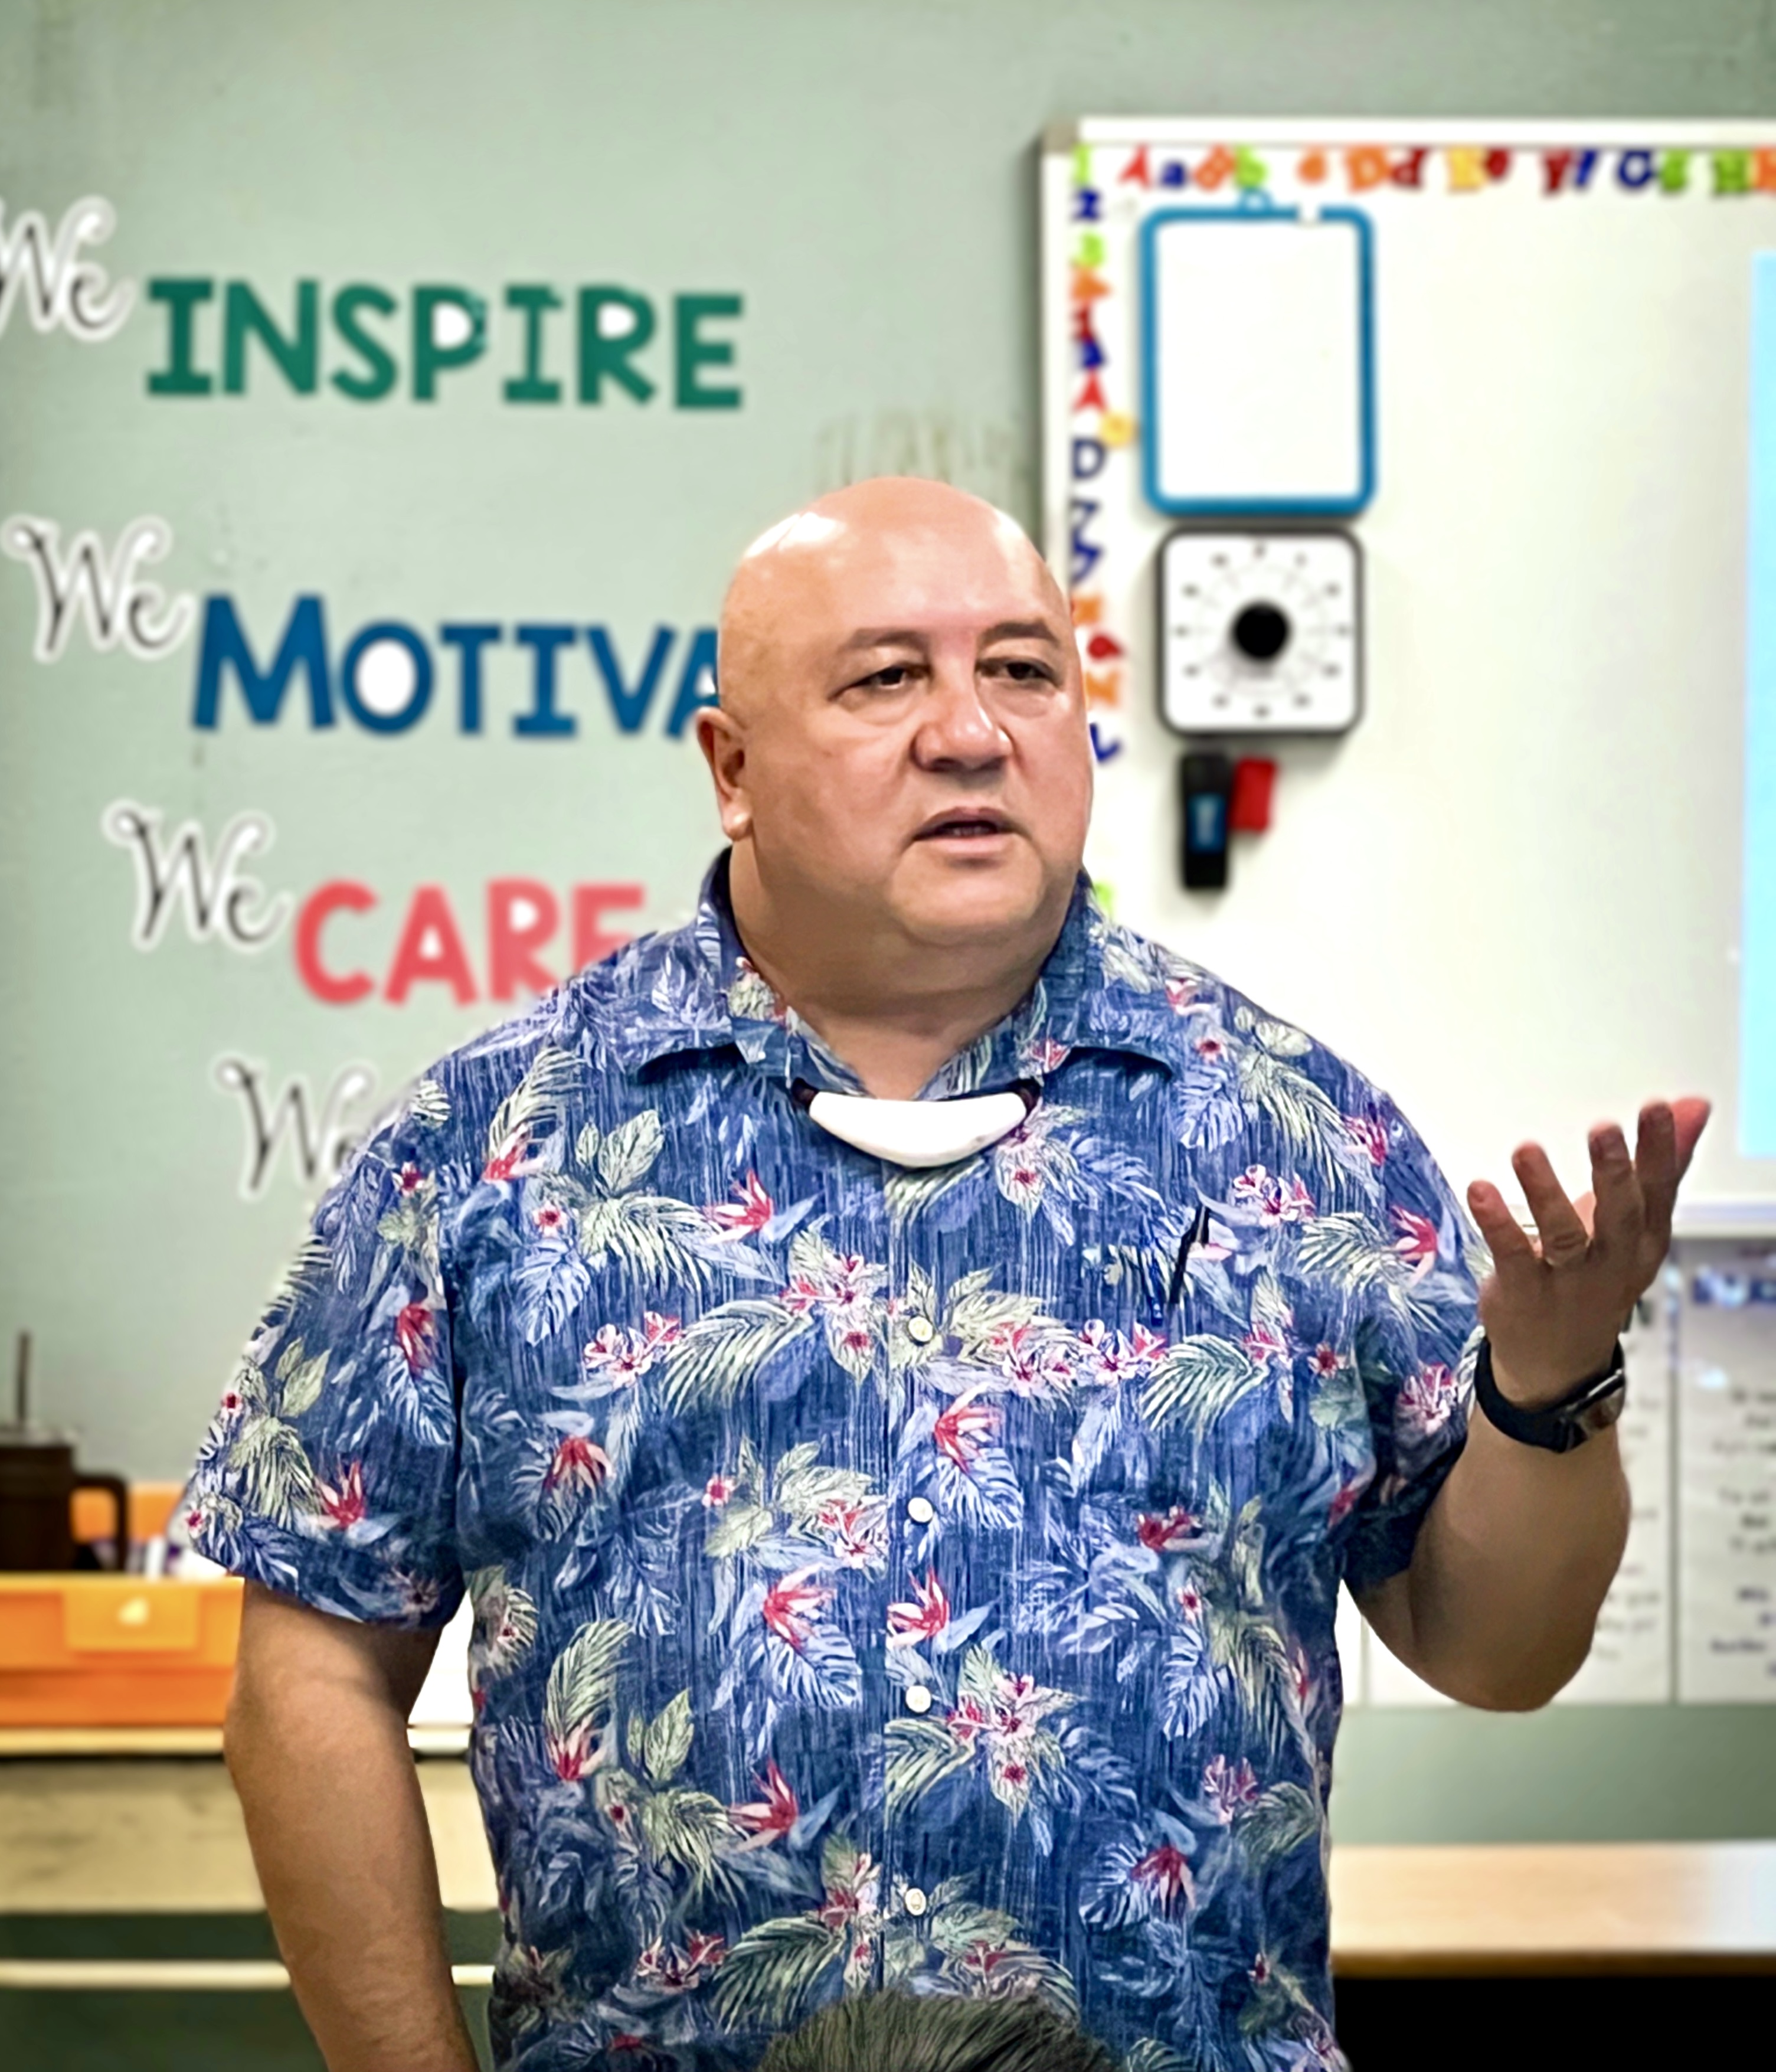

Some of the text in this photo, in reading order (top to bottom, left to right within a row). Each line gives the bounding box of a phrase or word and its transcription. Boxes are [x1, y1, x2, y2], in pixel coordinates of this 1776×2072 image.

[0, 195, 744, 410] We INSPIRE
[2, 514, 718, 741] We MOTIVA
[102, 798, 295, 950] We
[214, 1052, 378, 1201] W
